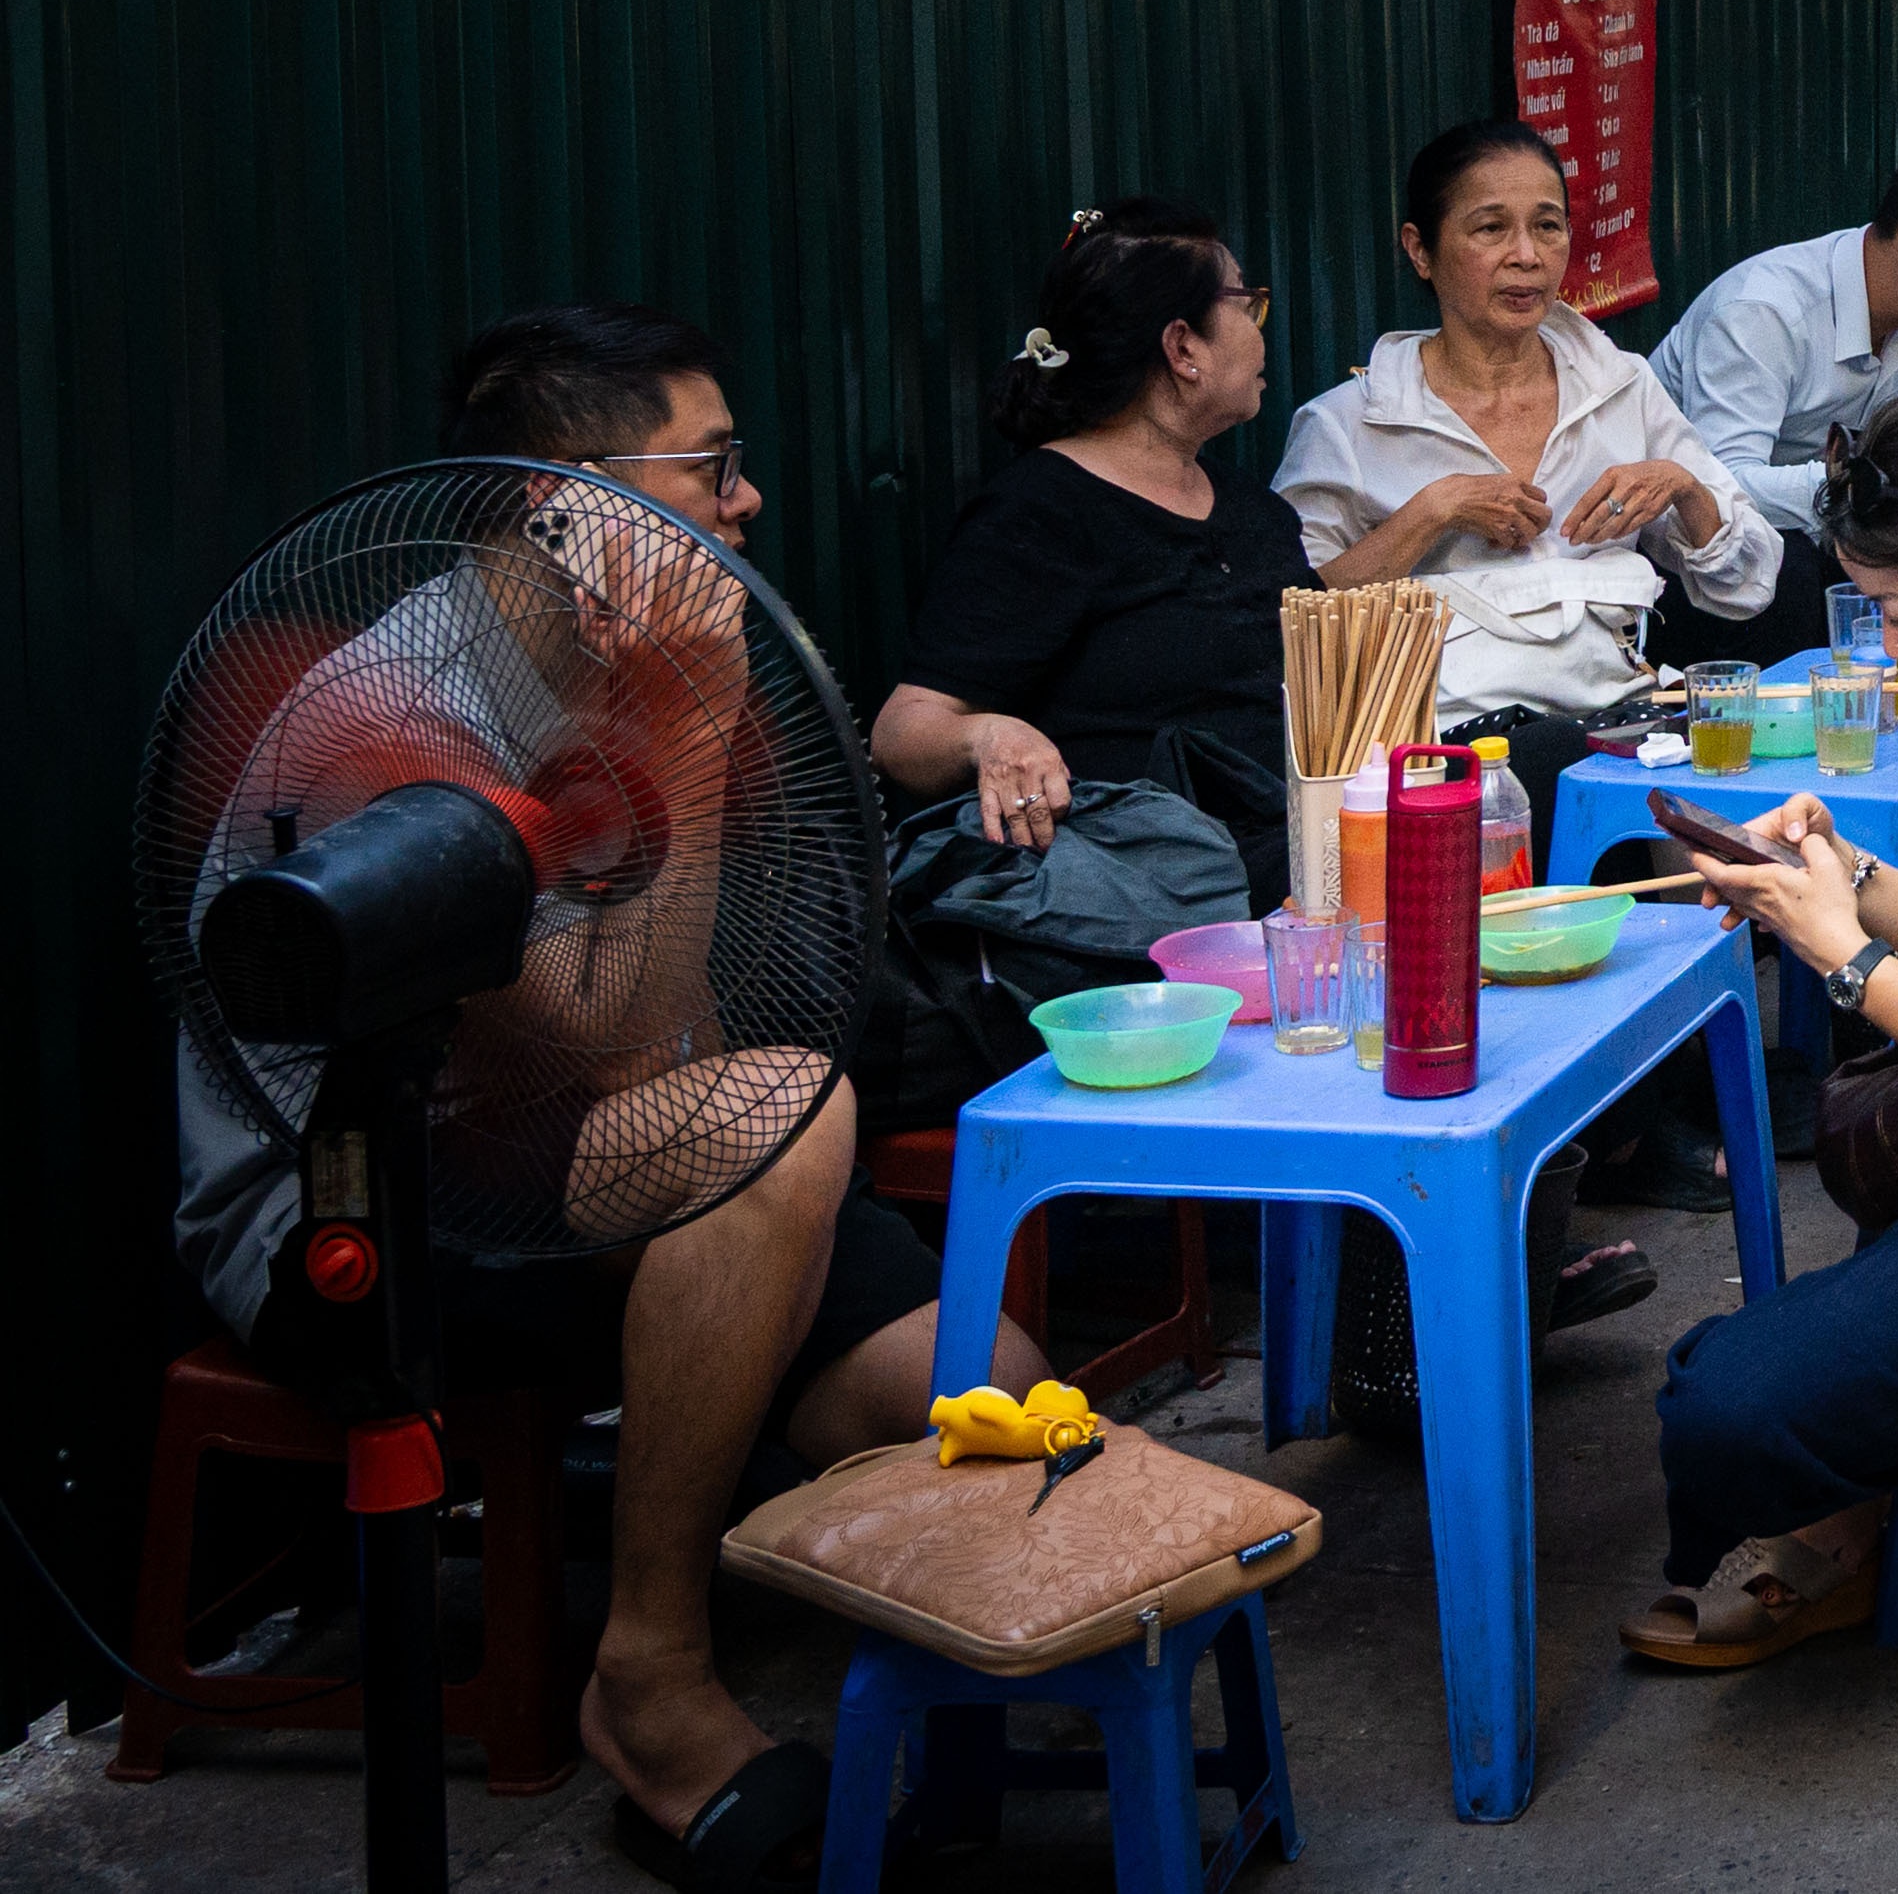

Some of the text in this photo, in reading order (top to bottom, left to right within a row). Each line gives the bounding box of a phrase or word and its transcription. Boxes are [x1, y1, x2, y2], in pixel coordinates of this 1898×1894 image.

[1527, 20, 1560, 44] Trà đá
[1589, 252, 1602, 274] C2
